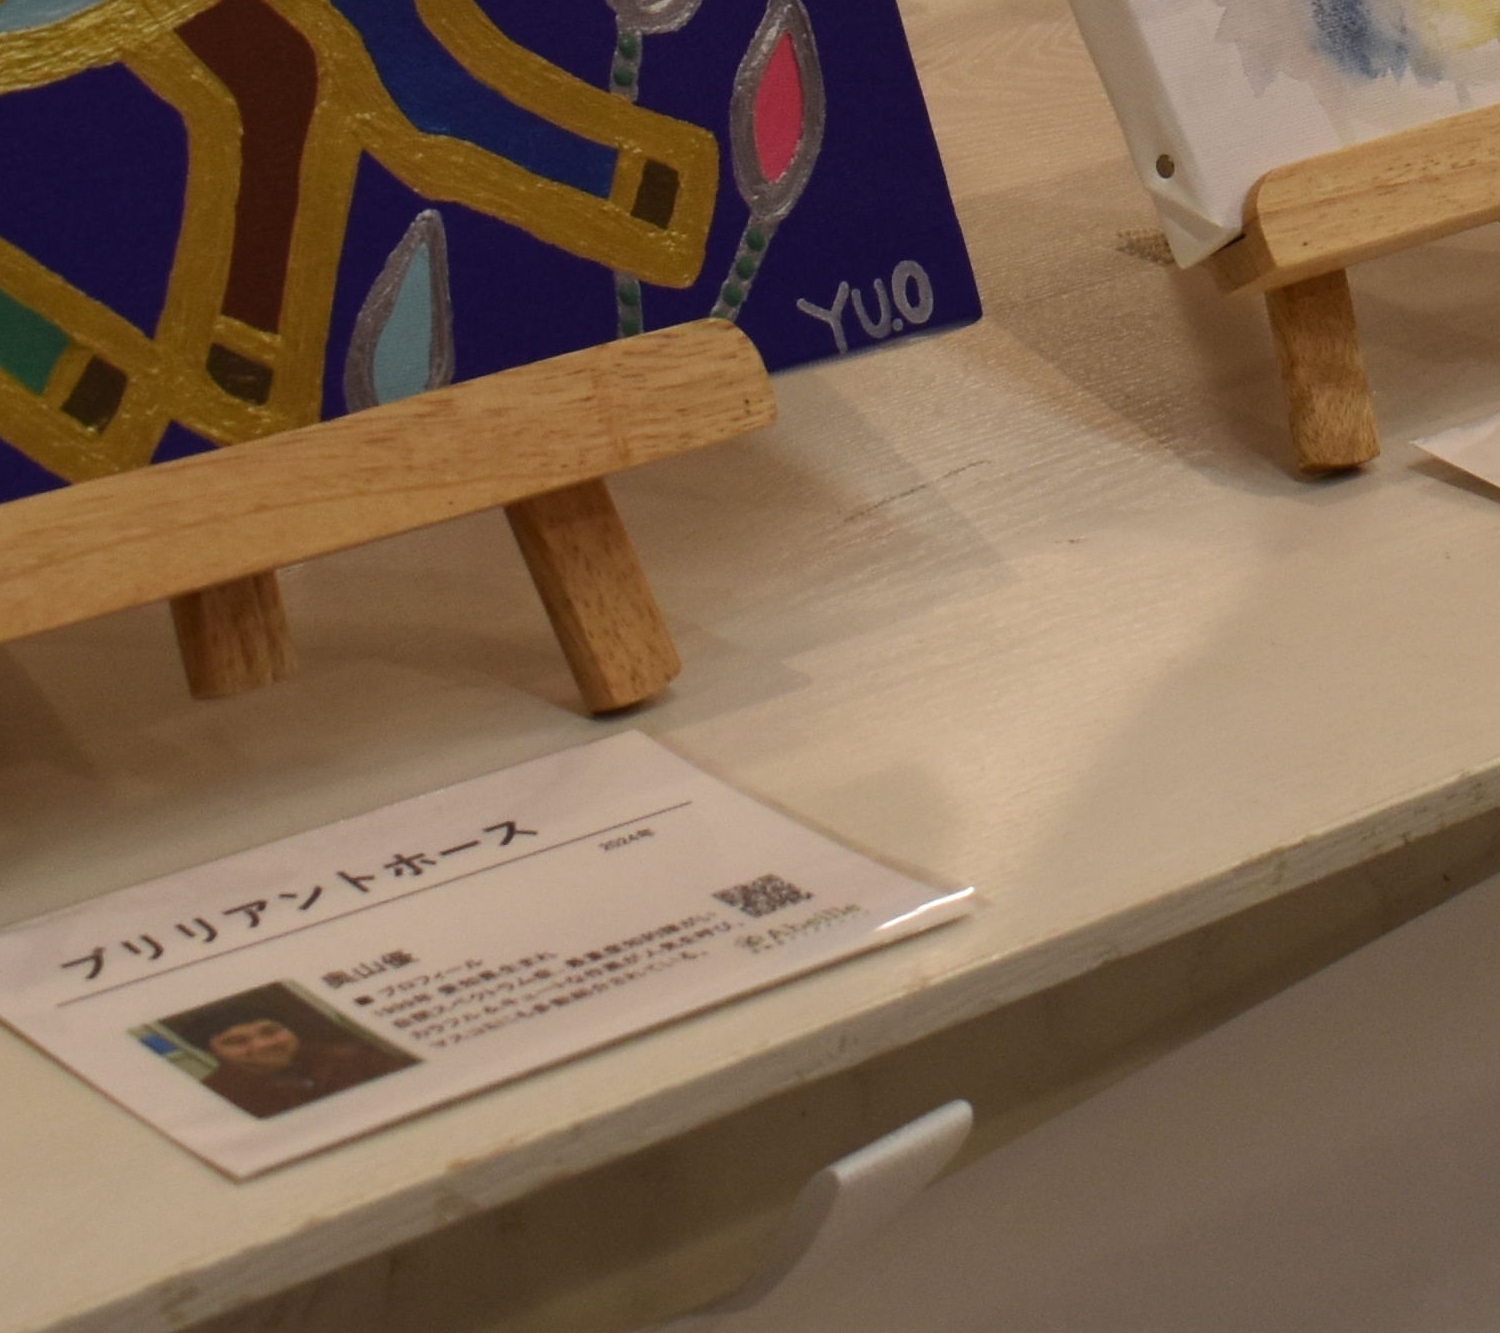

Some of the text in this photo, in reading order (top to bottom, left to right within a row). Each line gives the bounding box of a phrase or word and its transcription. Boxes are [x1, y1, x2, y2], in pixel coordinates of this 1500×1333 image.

[59, 818, 535, 981] ブリリアントホース
[378, 956, 485, 998] プロフィール
